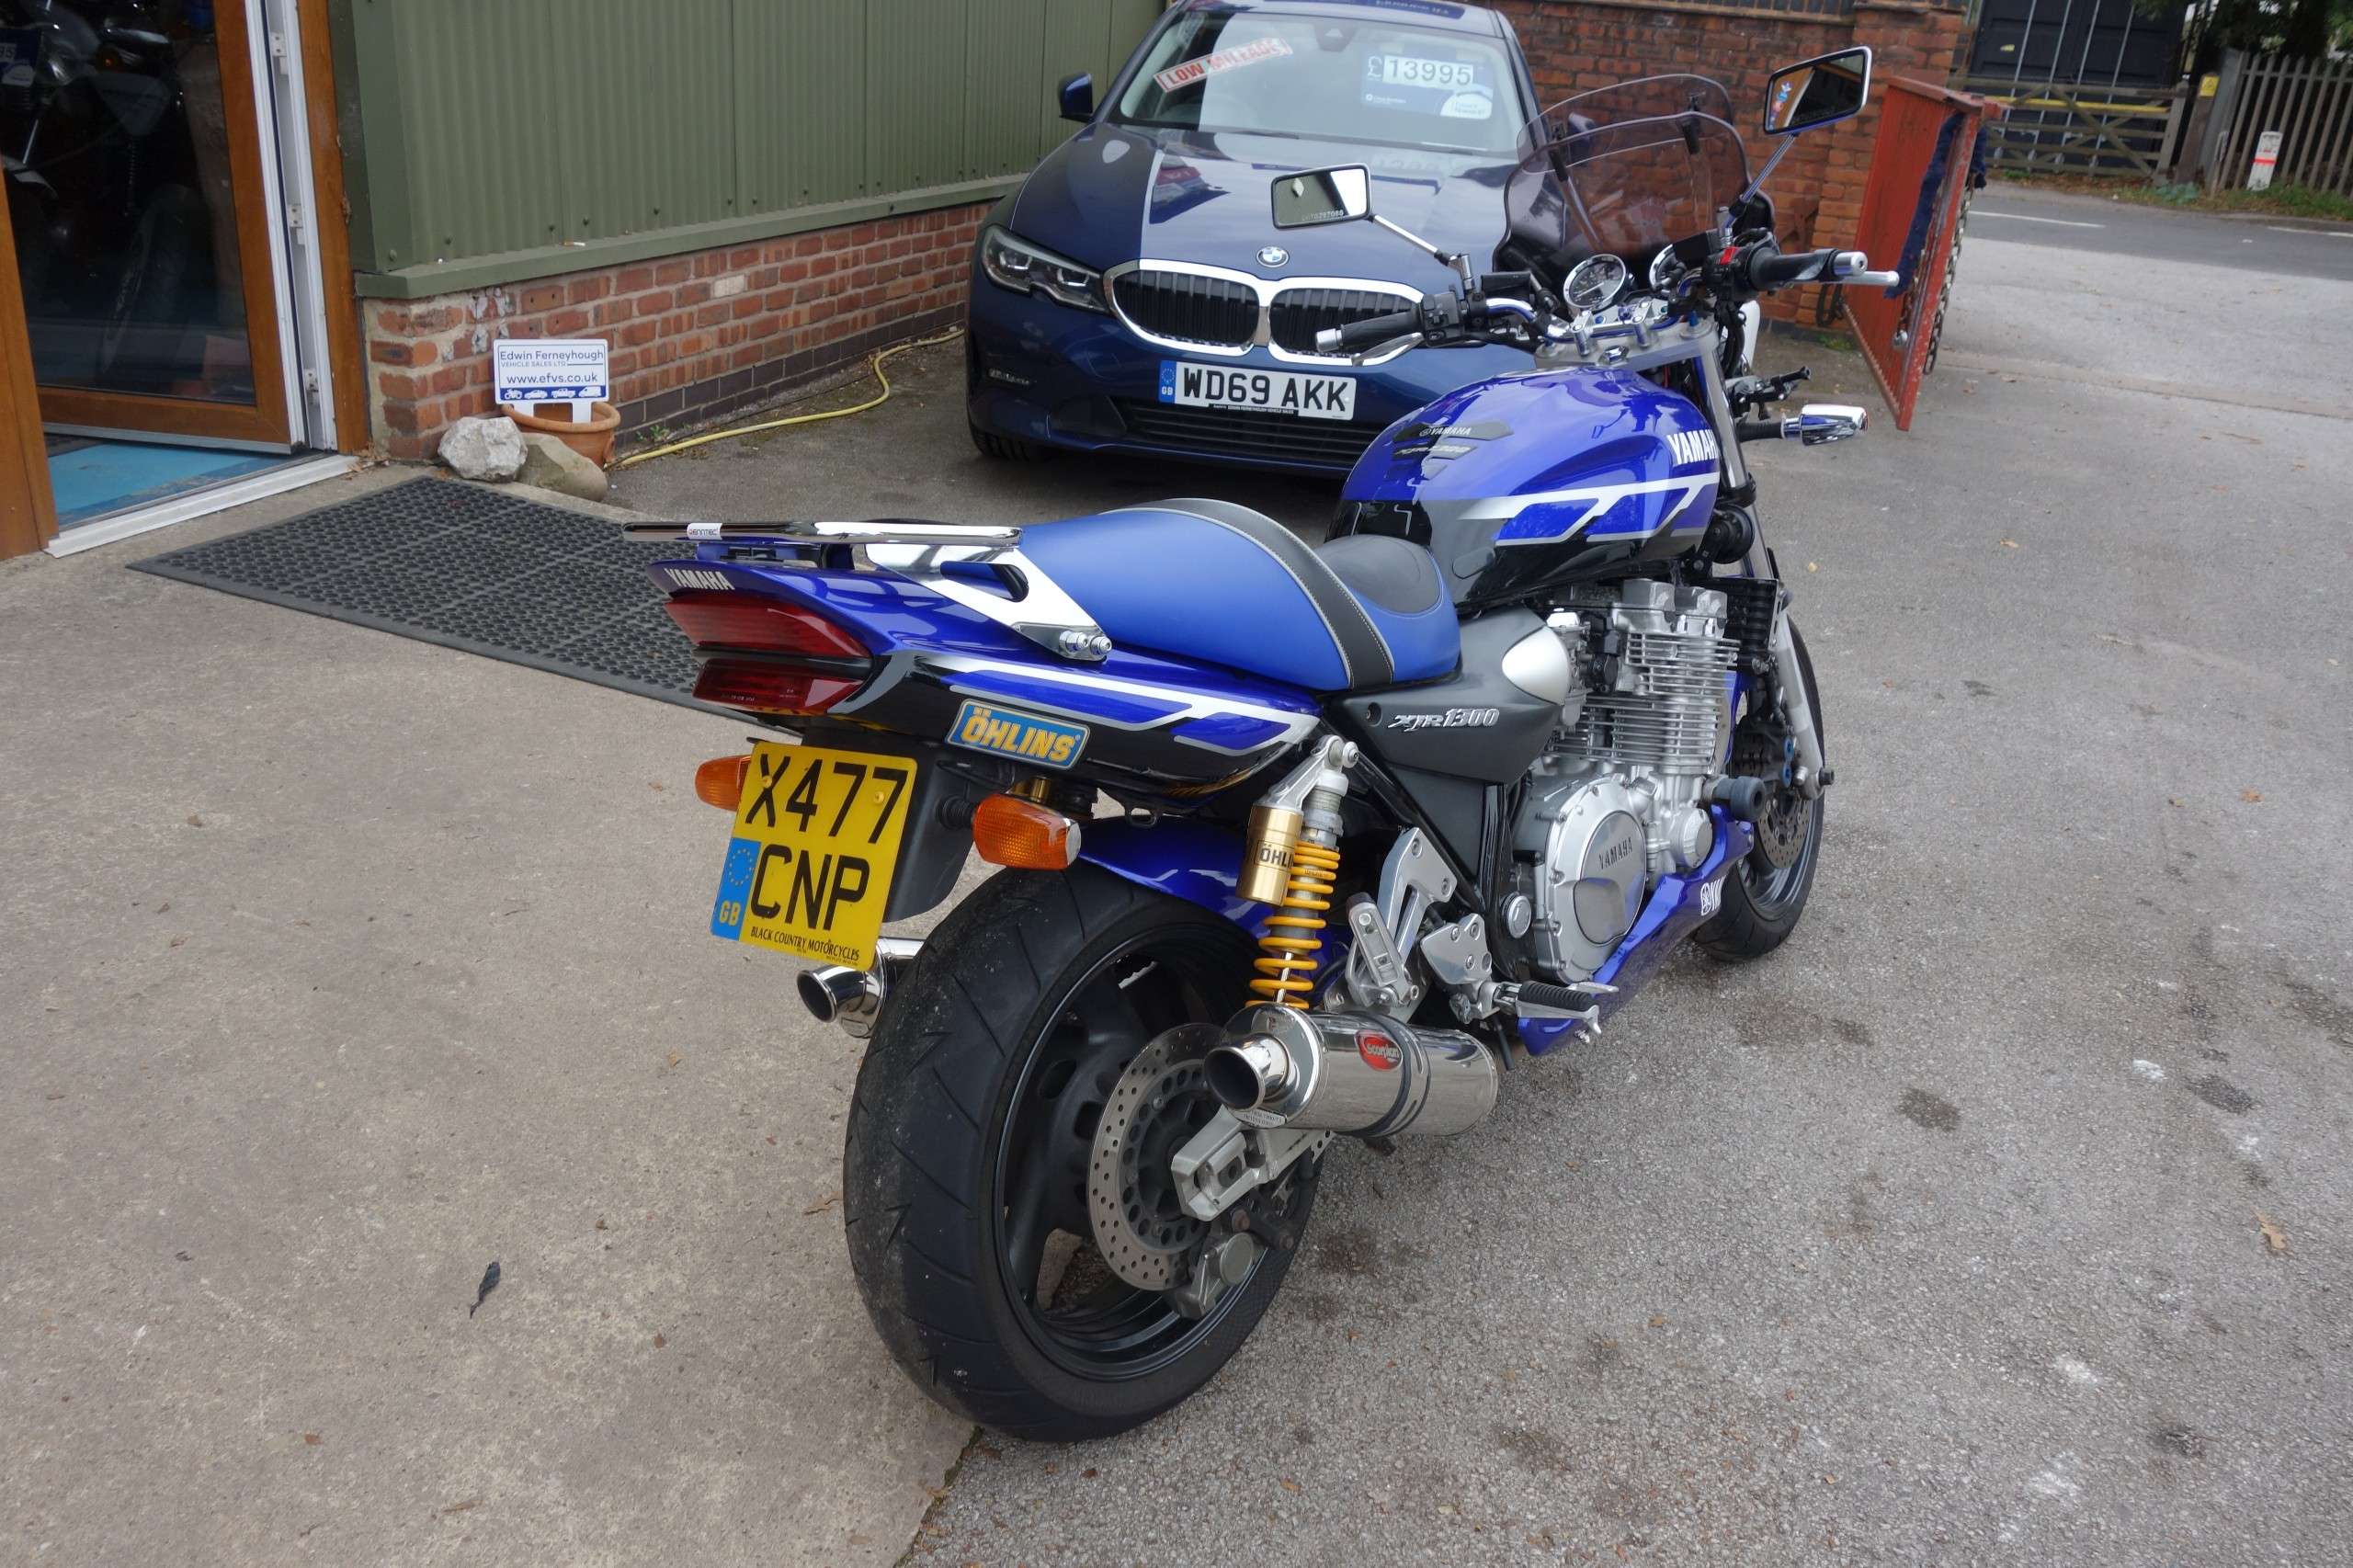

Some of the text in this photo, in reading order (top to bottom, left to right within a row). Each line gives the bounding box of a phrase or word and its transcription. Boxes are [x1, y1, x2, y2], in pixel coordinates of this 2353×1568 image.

[1166, 62, 1204, 85] LOW
[500, 349, 604, 361] Edwin Ferneyhough
[506, 372, 598, 384] www.efvs.co.uk
[1161, 386, 1174, 395] GB
[1183, 367, 1348, 412] WD69 AKK
[1430, 426, 1472, 436] YAMAHA
[1666, 428, 1718, 465] YAMAH
[665, 568, 734, 590] YAMAHA
[745, 753, 909, 845] X477
[1598, 836, 1632, 870] YAMAHA
[750, 844, 870, 931] CNP
[719, 901, 741, 926] GB
[750, 926, 773, 941] BLACK
[774, 929, 807, 949] COUNTRY
[808, 935, 860, 961] MOTORCYCLES
